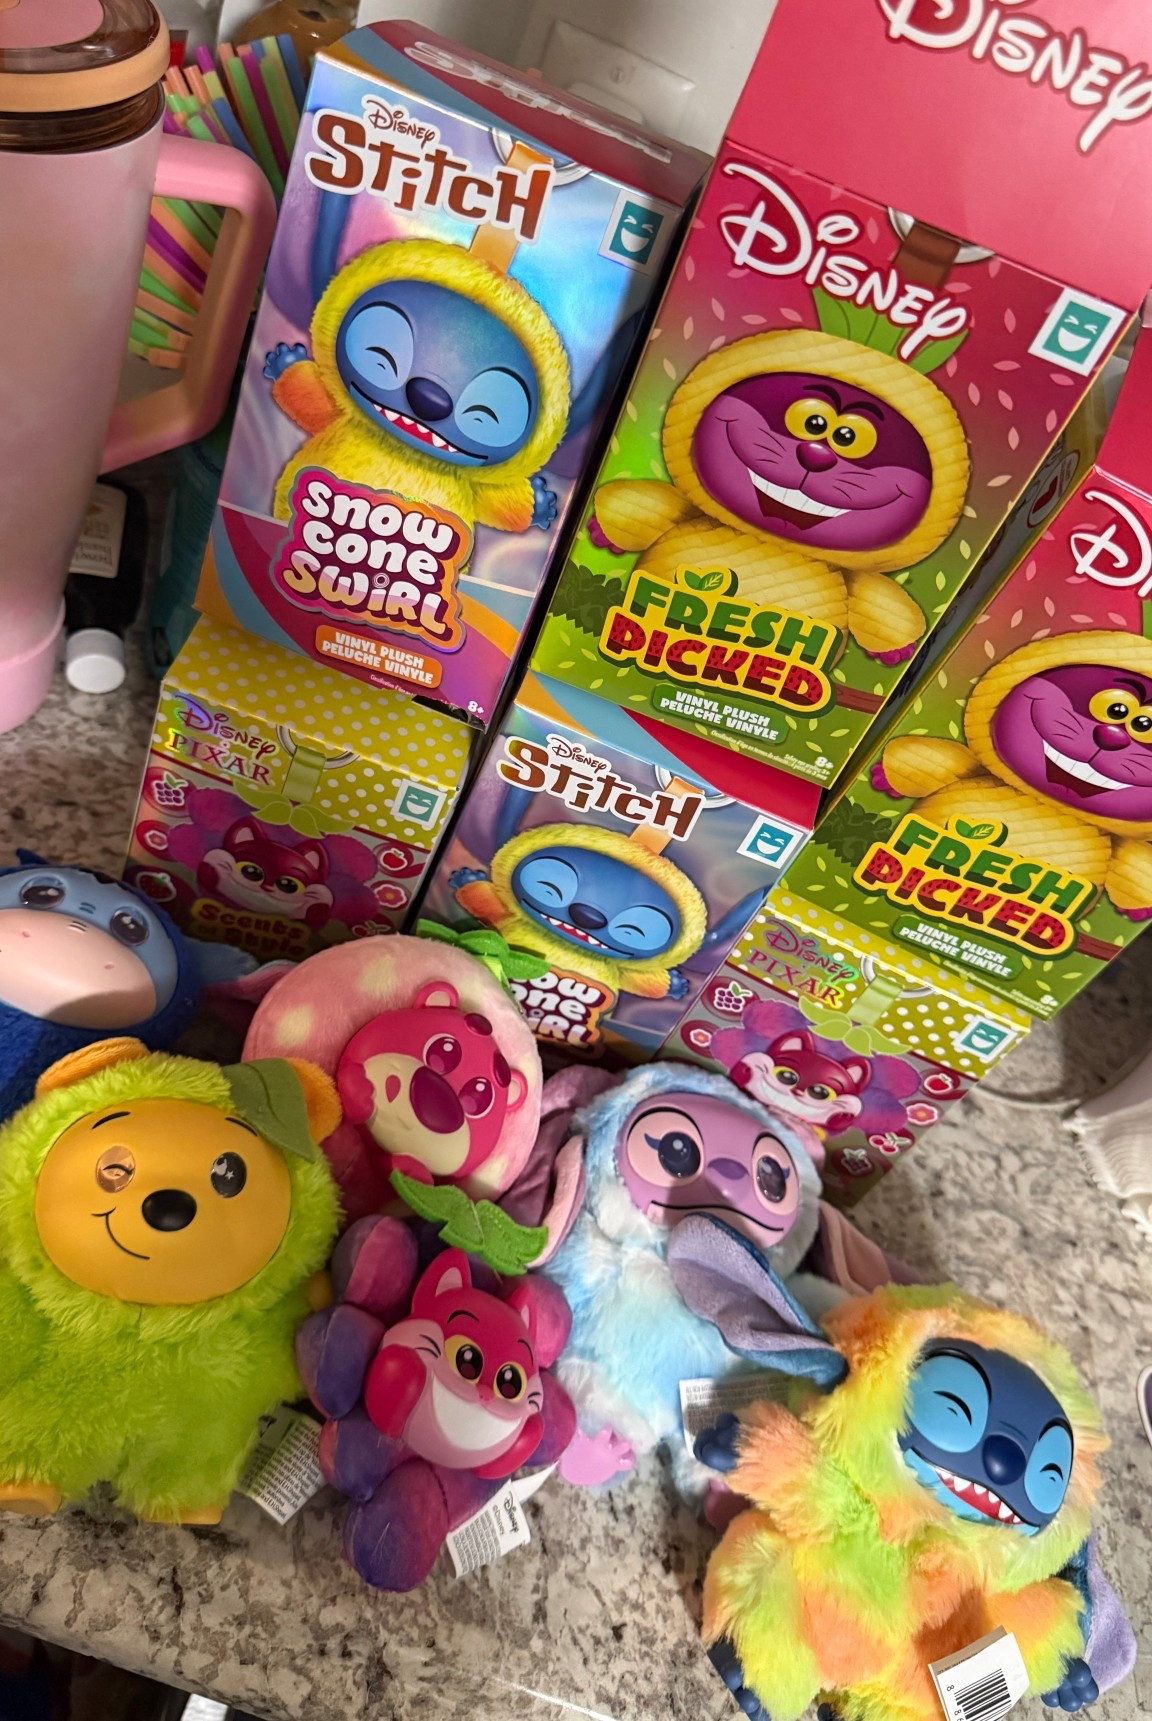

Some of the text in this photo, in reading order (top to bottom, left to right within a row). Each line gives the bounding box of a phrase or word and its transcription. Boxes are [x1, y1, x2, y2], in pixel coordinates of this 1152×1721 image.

[366, 99, 436, 149] Disney
[720, 162, 968, 360] Disney
[629, 575, 829, 666] FRESH
[322, 640, 434, 685] PELUCHE VINYLE
[335, 631, 425, 669] VINYL PLUSH
[605, 611, 824, 707] PICKED
[174, 694, 277, 760] Disney
[467, 700, 485, 714] 8+
[660, 697, 780, 741] PELUCHE VINYLE
[675, 691, 771, 728] VINYL PLUSH
[169, 733, 271, 786] PIXAR
[550, 737, 608, 774] Disney
[815, 756, 834, 769] 8+
[893, 819, 1085, 915] FRESH
[860, 847, 1066, 950] PICKED
[765, 918, 855, 983] Disney
[900, 927, 1013, 977] PELUCHE VINYLE
[917, 922, 1007, 964] VINYL PLUSH
[748, 949, 842, 1007] PIXAR
